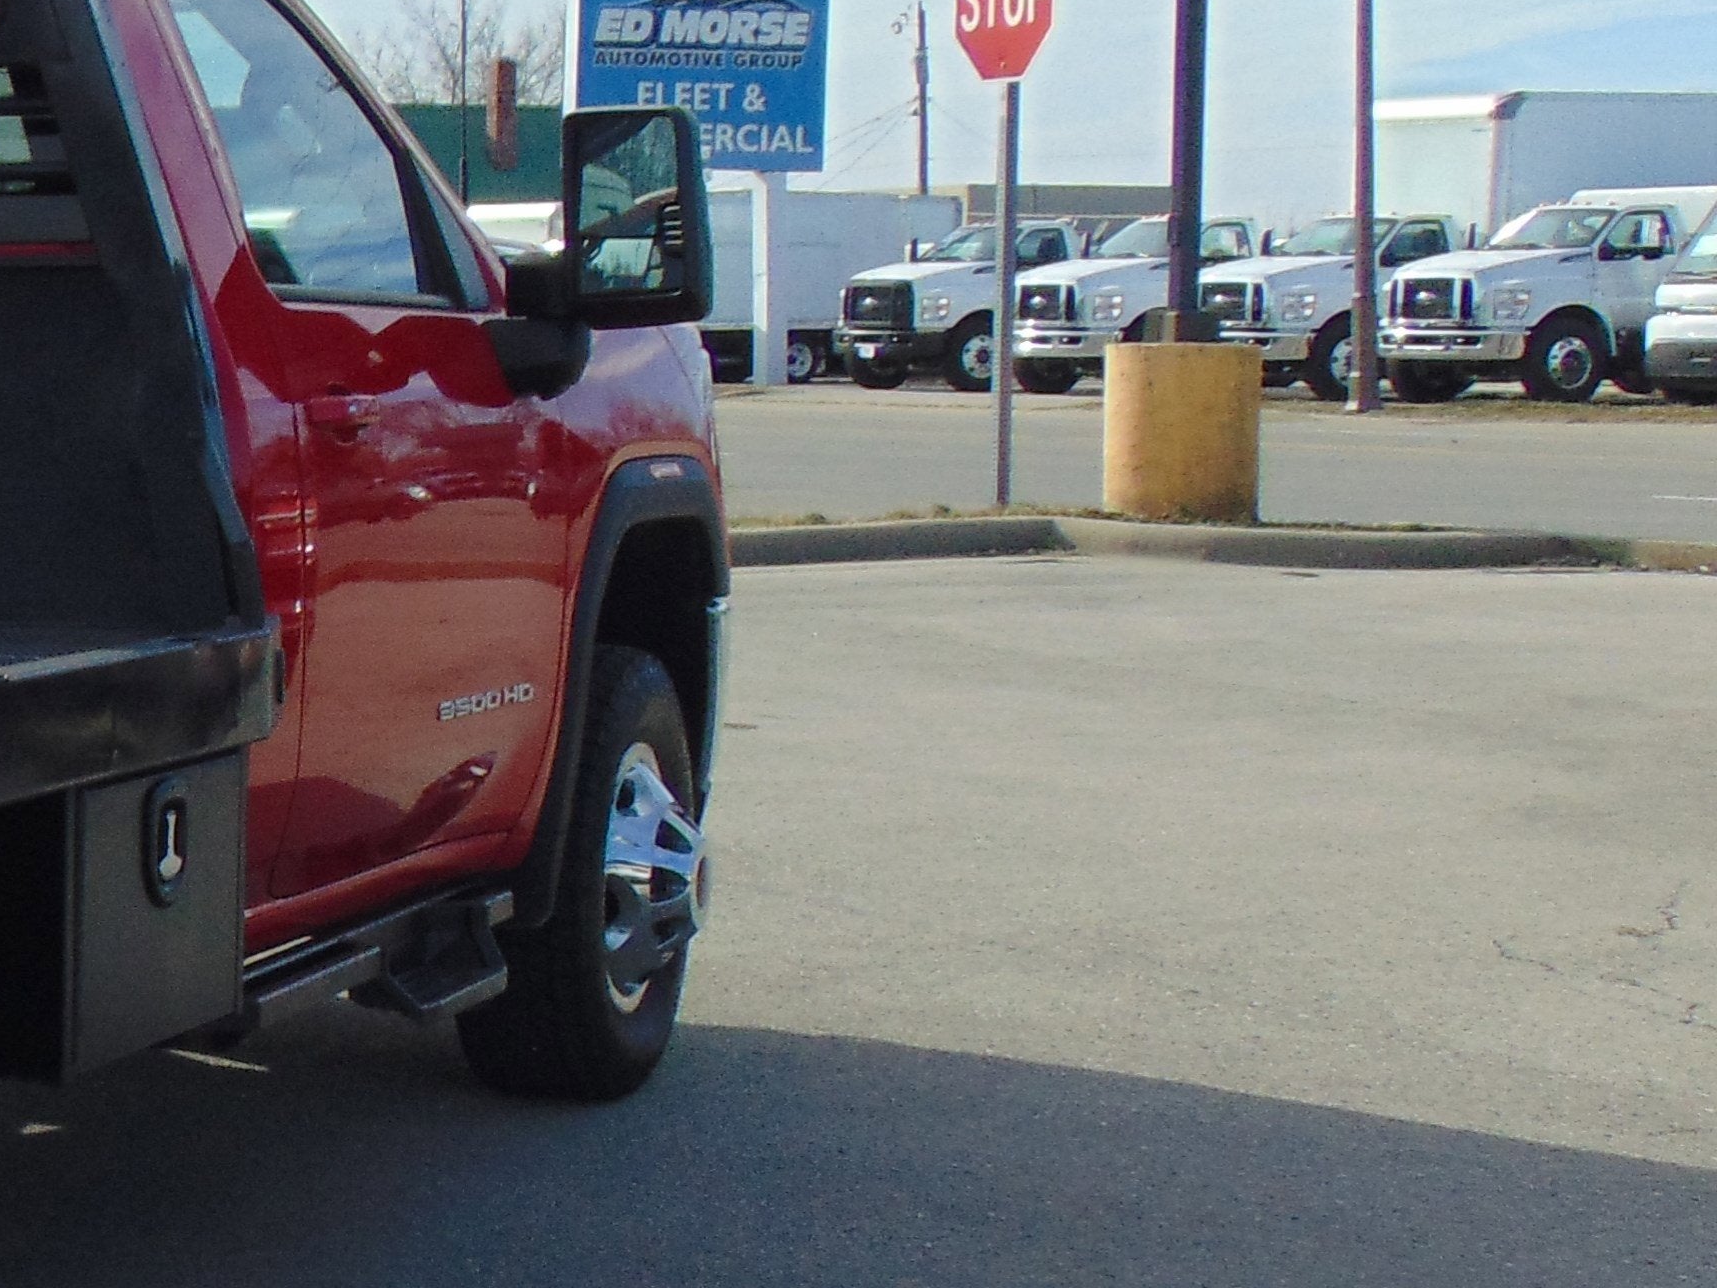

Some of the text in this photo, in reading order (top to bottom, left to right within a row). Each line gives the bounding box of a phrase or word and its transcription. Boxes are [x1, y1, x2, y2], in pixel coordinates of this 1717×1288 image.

[594, 9, 811, 50] ED MORSE
[594, 50, 803, 69] AUTOMOTIVE GROUP
[742, 83, 767, 112] &
[699, 123, 815, 153] ERCIAL
